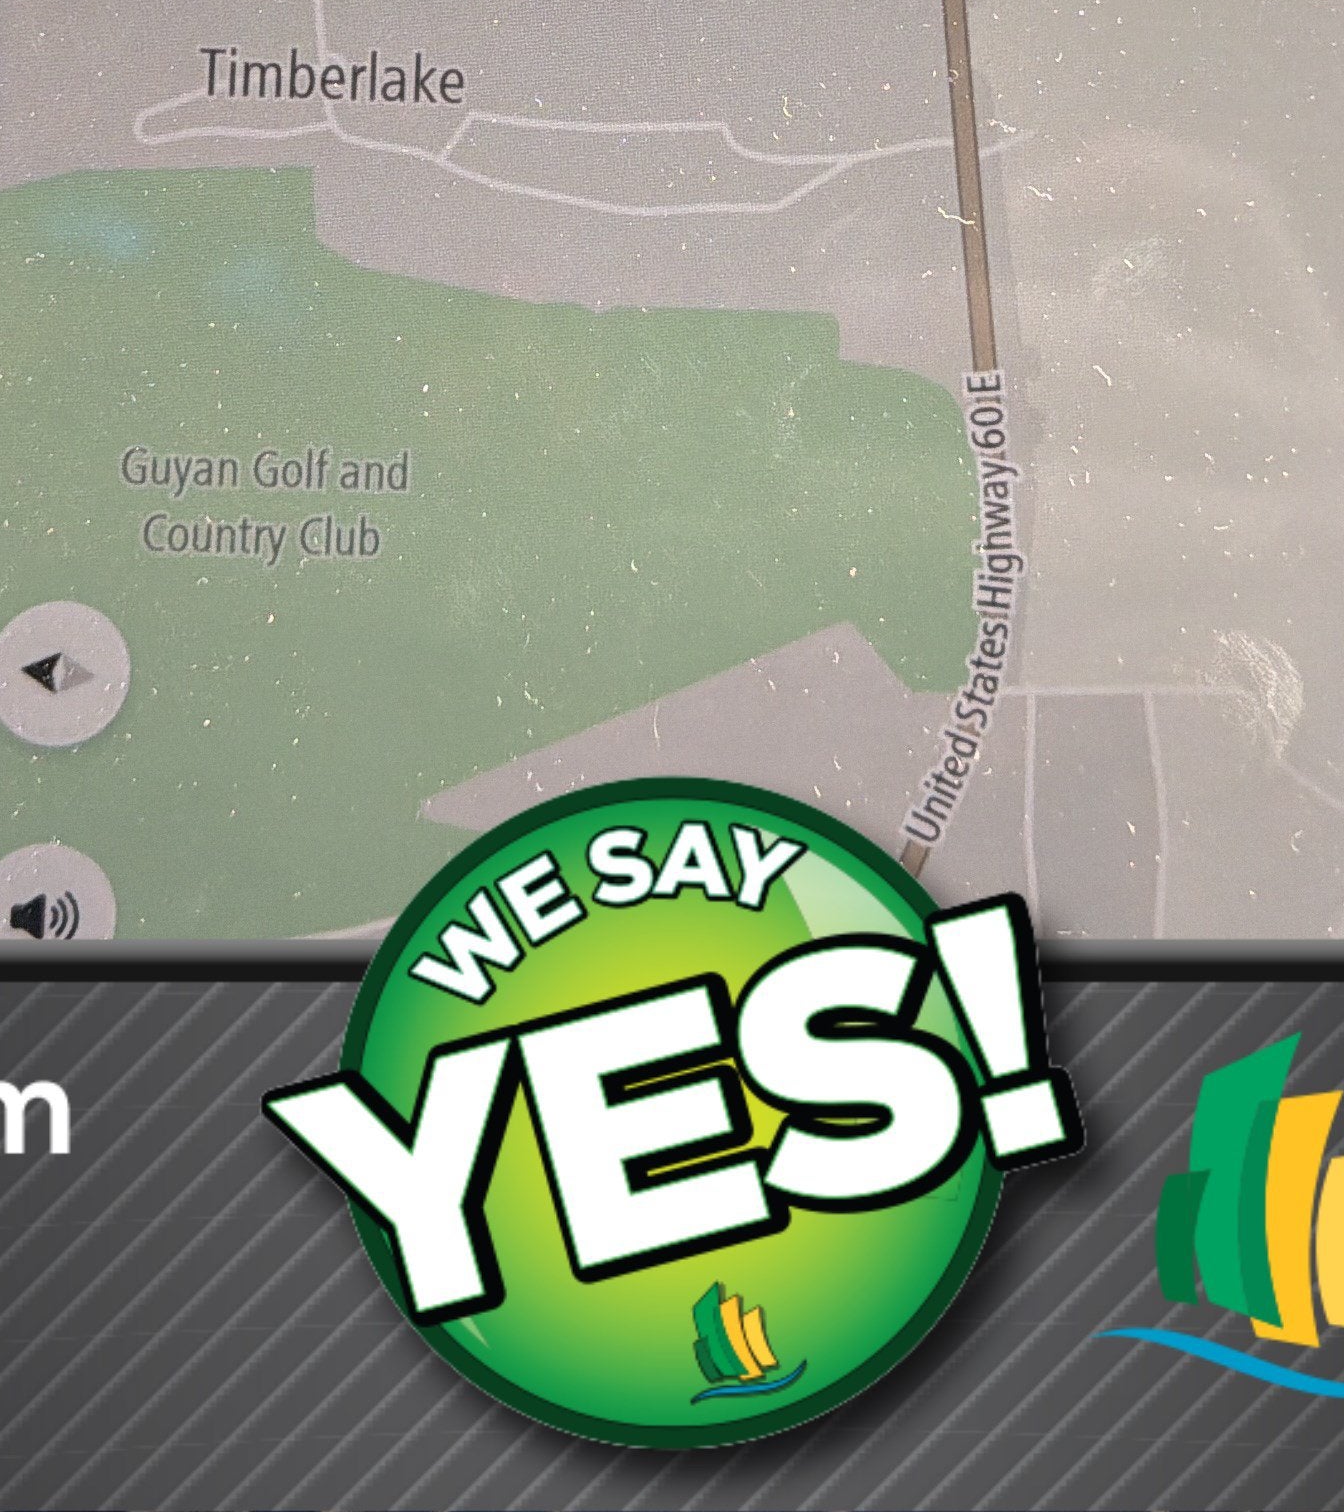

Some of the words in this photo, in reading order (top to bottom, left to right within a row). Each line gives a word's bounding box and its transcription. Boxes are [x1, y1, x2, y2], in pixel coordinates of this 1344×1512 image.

[199, 46, 465, 104] Timberlake
[970, 405, 1006, 449] 60
[121, 445, 239, 497] Guyan
[253, 448, 329, 489] Golf
[339, 451, 410, 491] and
[142, 513, 286, 565] Country
[299, 516, 382, 558] Club
[975, 458, 1023, 609] Highway
[956, 621, 1009, 729] States
[907, 730, 981, 843] United
